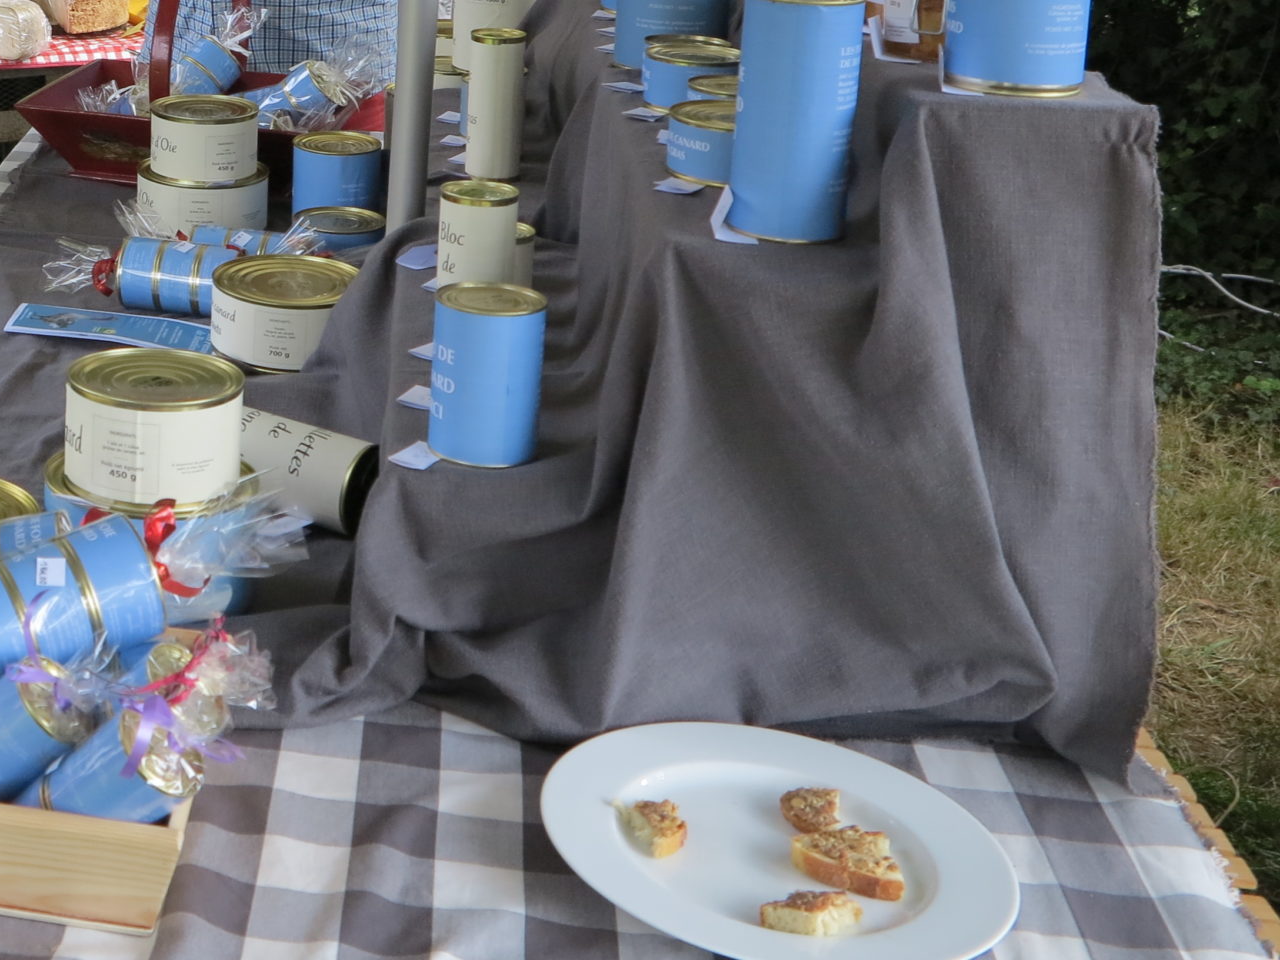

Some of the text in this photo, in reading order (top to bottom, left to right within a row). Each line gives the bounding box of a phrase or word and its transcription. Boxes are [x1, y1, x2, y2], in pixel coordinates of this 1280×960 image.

[440, 220, 465, 246] Bloc
[442, 253, 456, 275] de
[268, 350, 282, 358] 700
[438, 344, 456, 366] DE
[108, 468, 137, 482] 450 g
